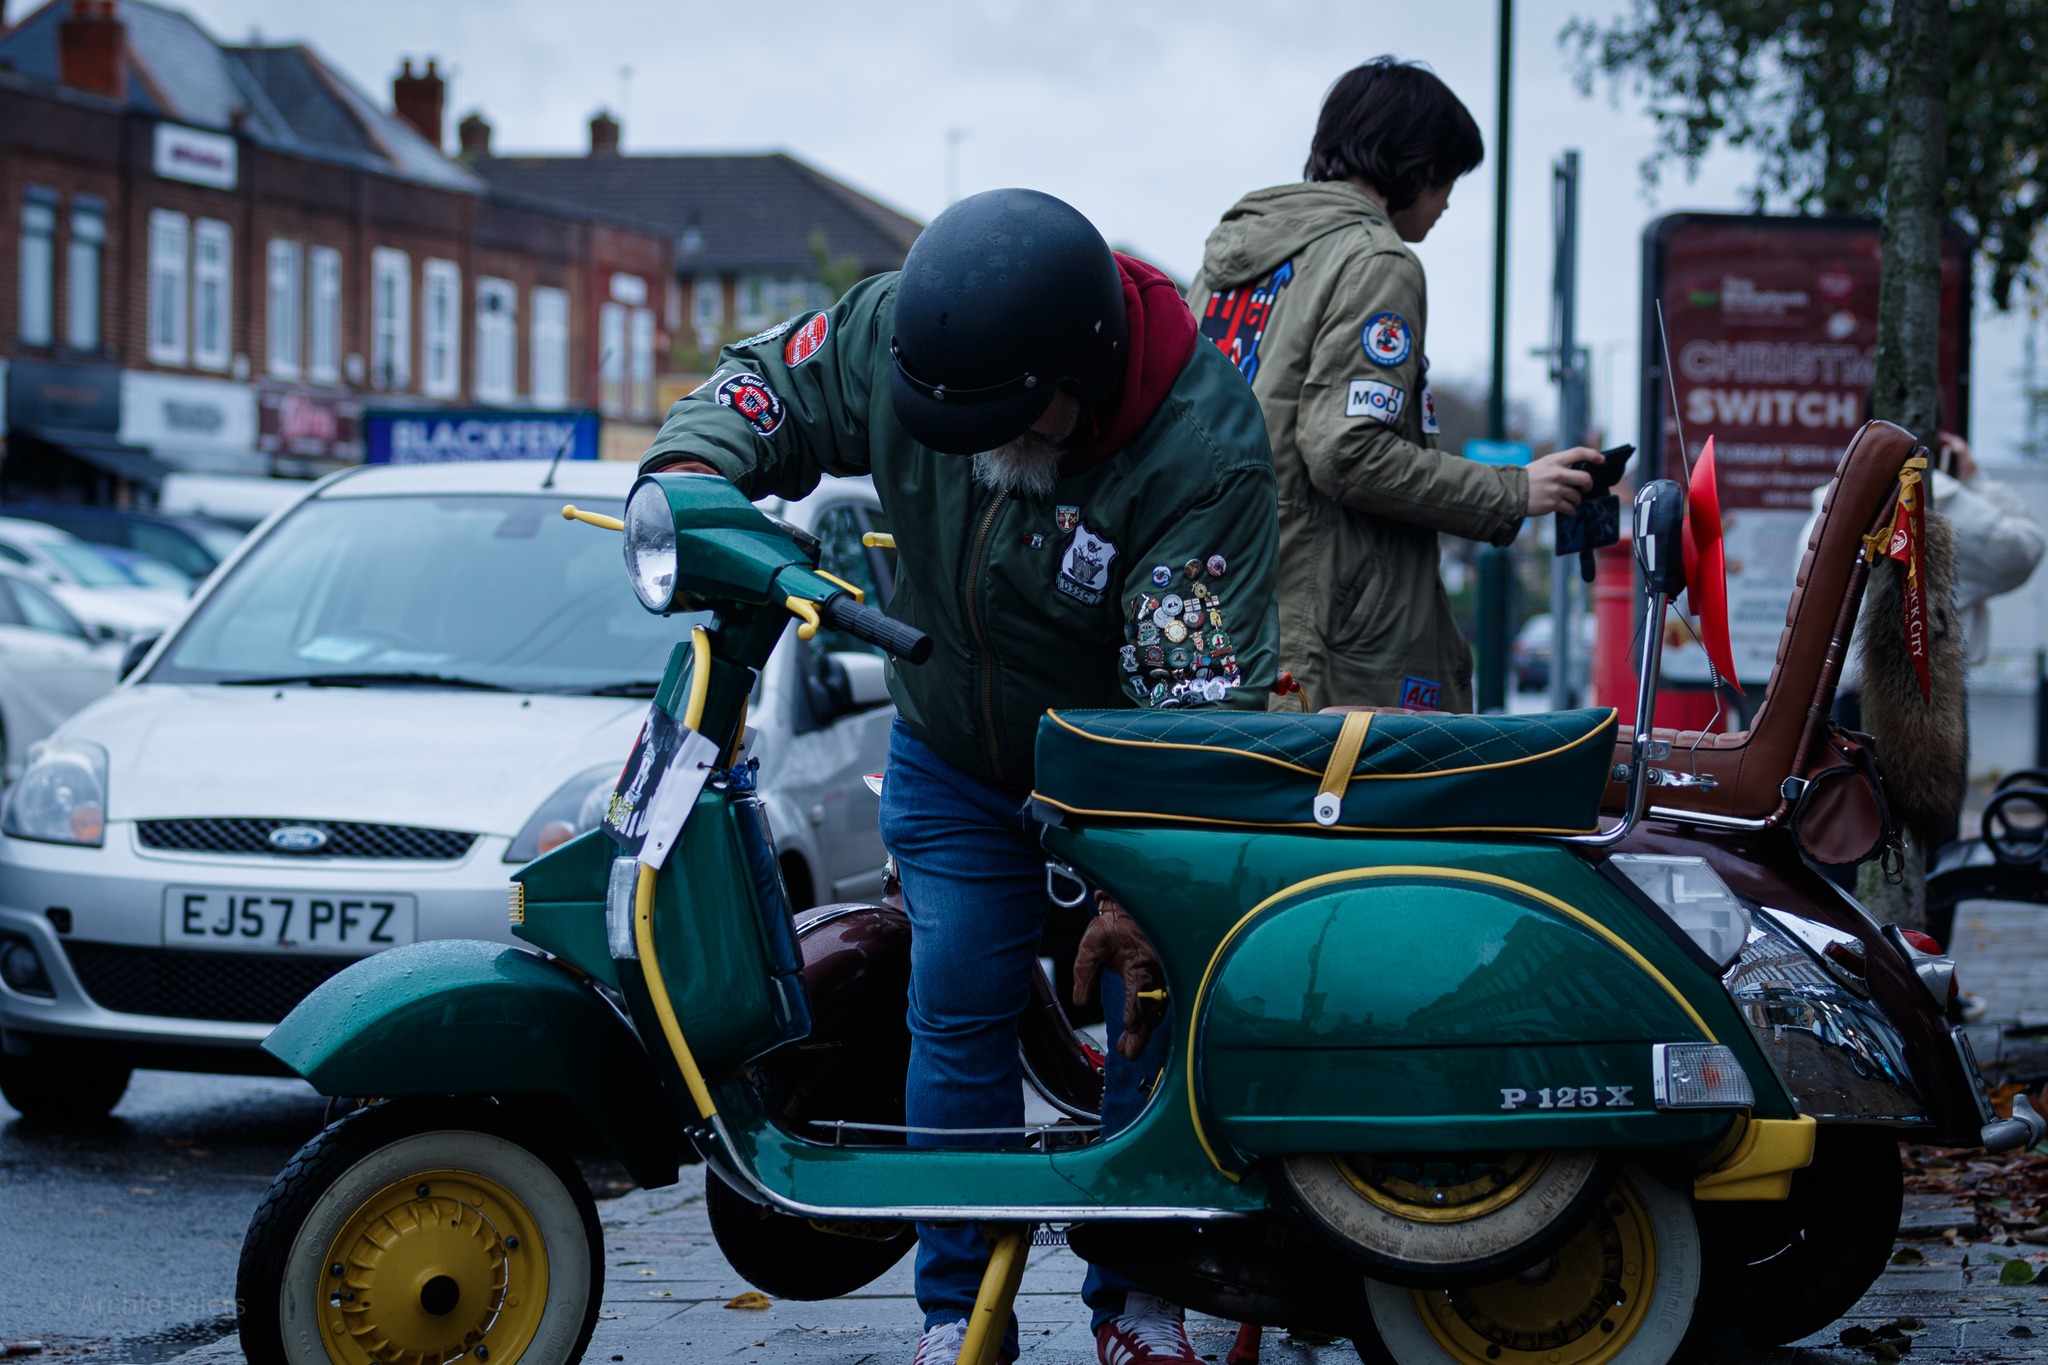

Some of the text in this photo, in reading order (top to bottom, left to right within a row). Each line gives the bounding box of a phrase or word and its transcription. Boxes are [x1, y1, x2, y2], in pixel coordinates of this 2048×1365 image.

[746, 386, 769, 409] OCTOBER
[1353, 391, 1398, 414] MOD
[1686, 388, 1857, 427] SWITCH
[1062, 580, 1091, 600] DSSC
[1908, 582, 1923, 657] OCK CITY
[182, 895, 395, 943] EJ57 PFZ
[1500, 1086, 1634, 1109] P 125 X
